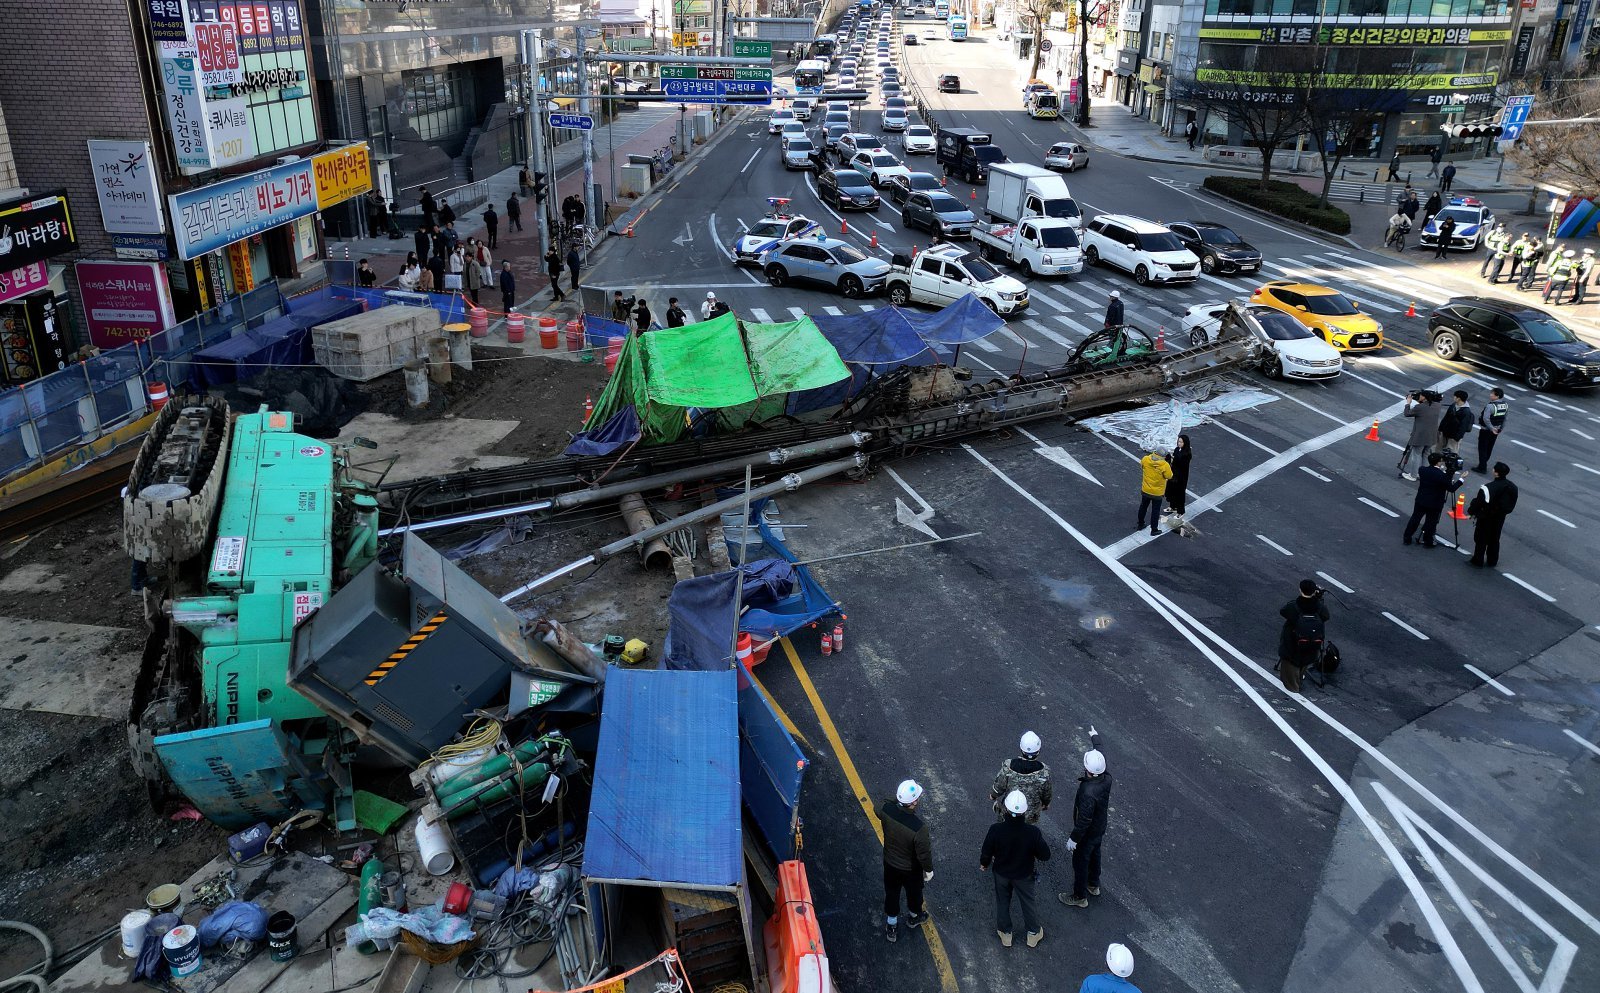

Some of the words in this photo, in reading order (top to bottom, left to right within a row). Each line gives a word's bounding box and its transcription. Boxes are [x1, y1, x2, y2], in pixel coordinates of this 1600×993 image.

[151, 0, 181, 17] 학원
[1279, 27, 1312, 43] 만촌
[197, 29, 212, 67] 내신
[211, 27, 223, 66] HSK
[223, 70, 235, 83] (4층)
[669, 68, 684, 78] 경산
[178, 75, 195, 95] 류
[682, 81, 715, 93] 달구벌대로
[171, 94, 192, 153] 정신건강
[191, 120, 202, 146] 의학과
[99, 162, 120, 175] 가연
[316, 151, 367, 191] 한사랑약국
[106, 190, 147, 203] 아카데미
[182, 186, 250, 245] 김피부과
[257, 170, 312, 214] 비뇨기과
[14, 220, 61, 248] 마라탕
[12, 262, 42, 289] 안경
[105, 279, 138, 292] 스쿼시
[104, 326, 151, 337] 742-1207
